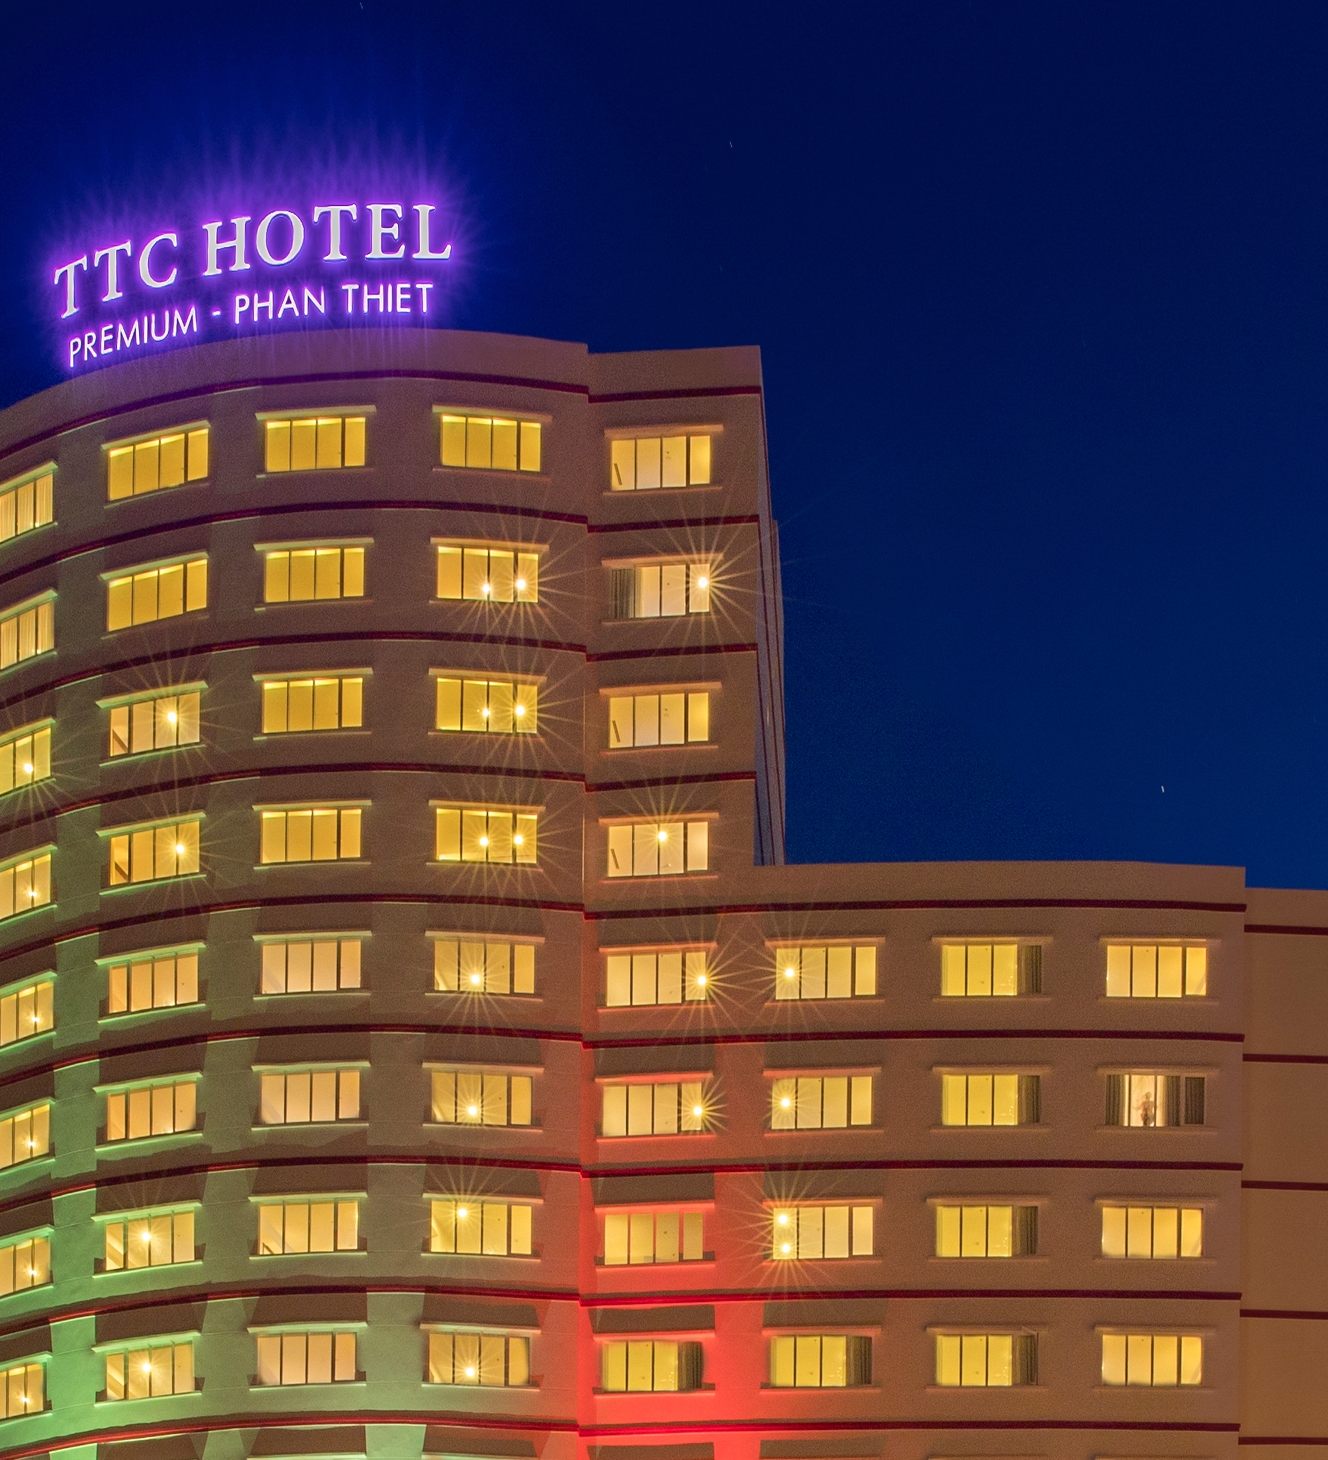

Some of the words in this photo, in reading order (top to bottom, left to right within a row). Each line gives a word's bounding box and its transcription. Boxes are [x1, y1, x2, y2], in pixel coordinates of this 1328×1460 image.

[54, 233, 178, 319] TTC
[201, 203, 452, 276] HOTEL
[68, 305, 199, 368] PREMIUM
[233, 287, 326, 325] PHAN
[341, 282, 434, 314] THIET
